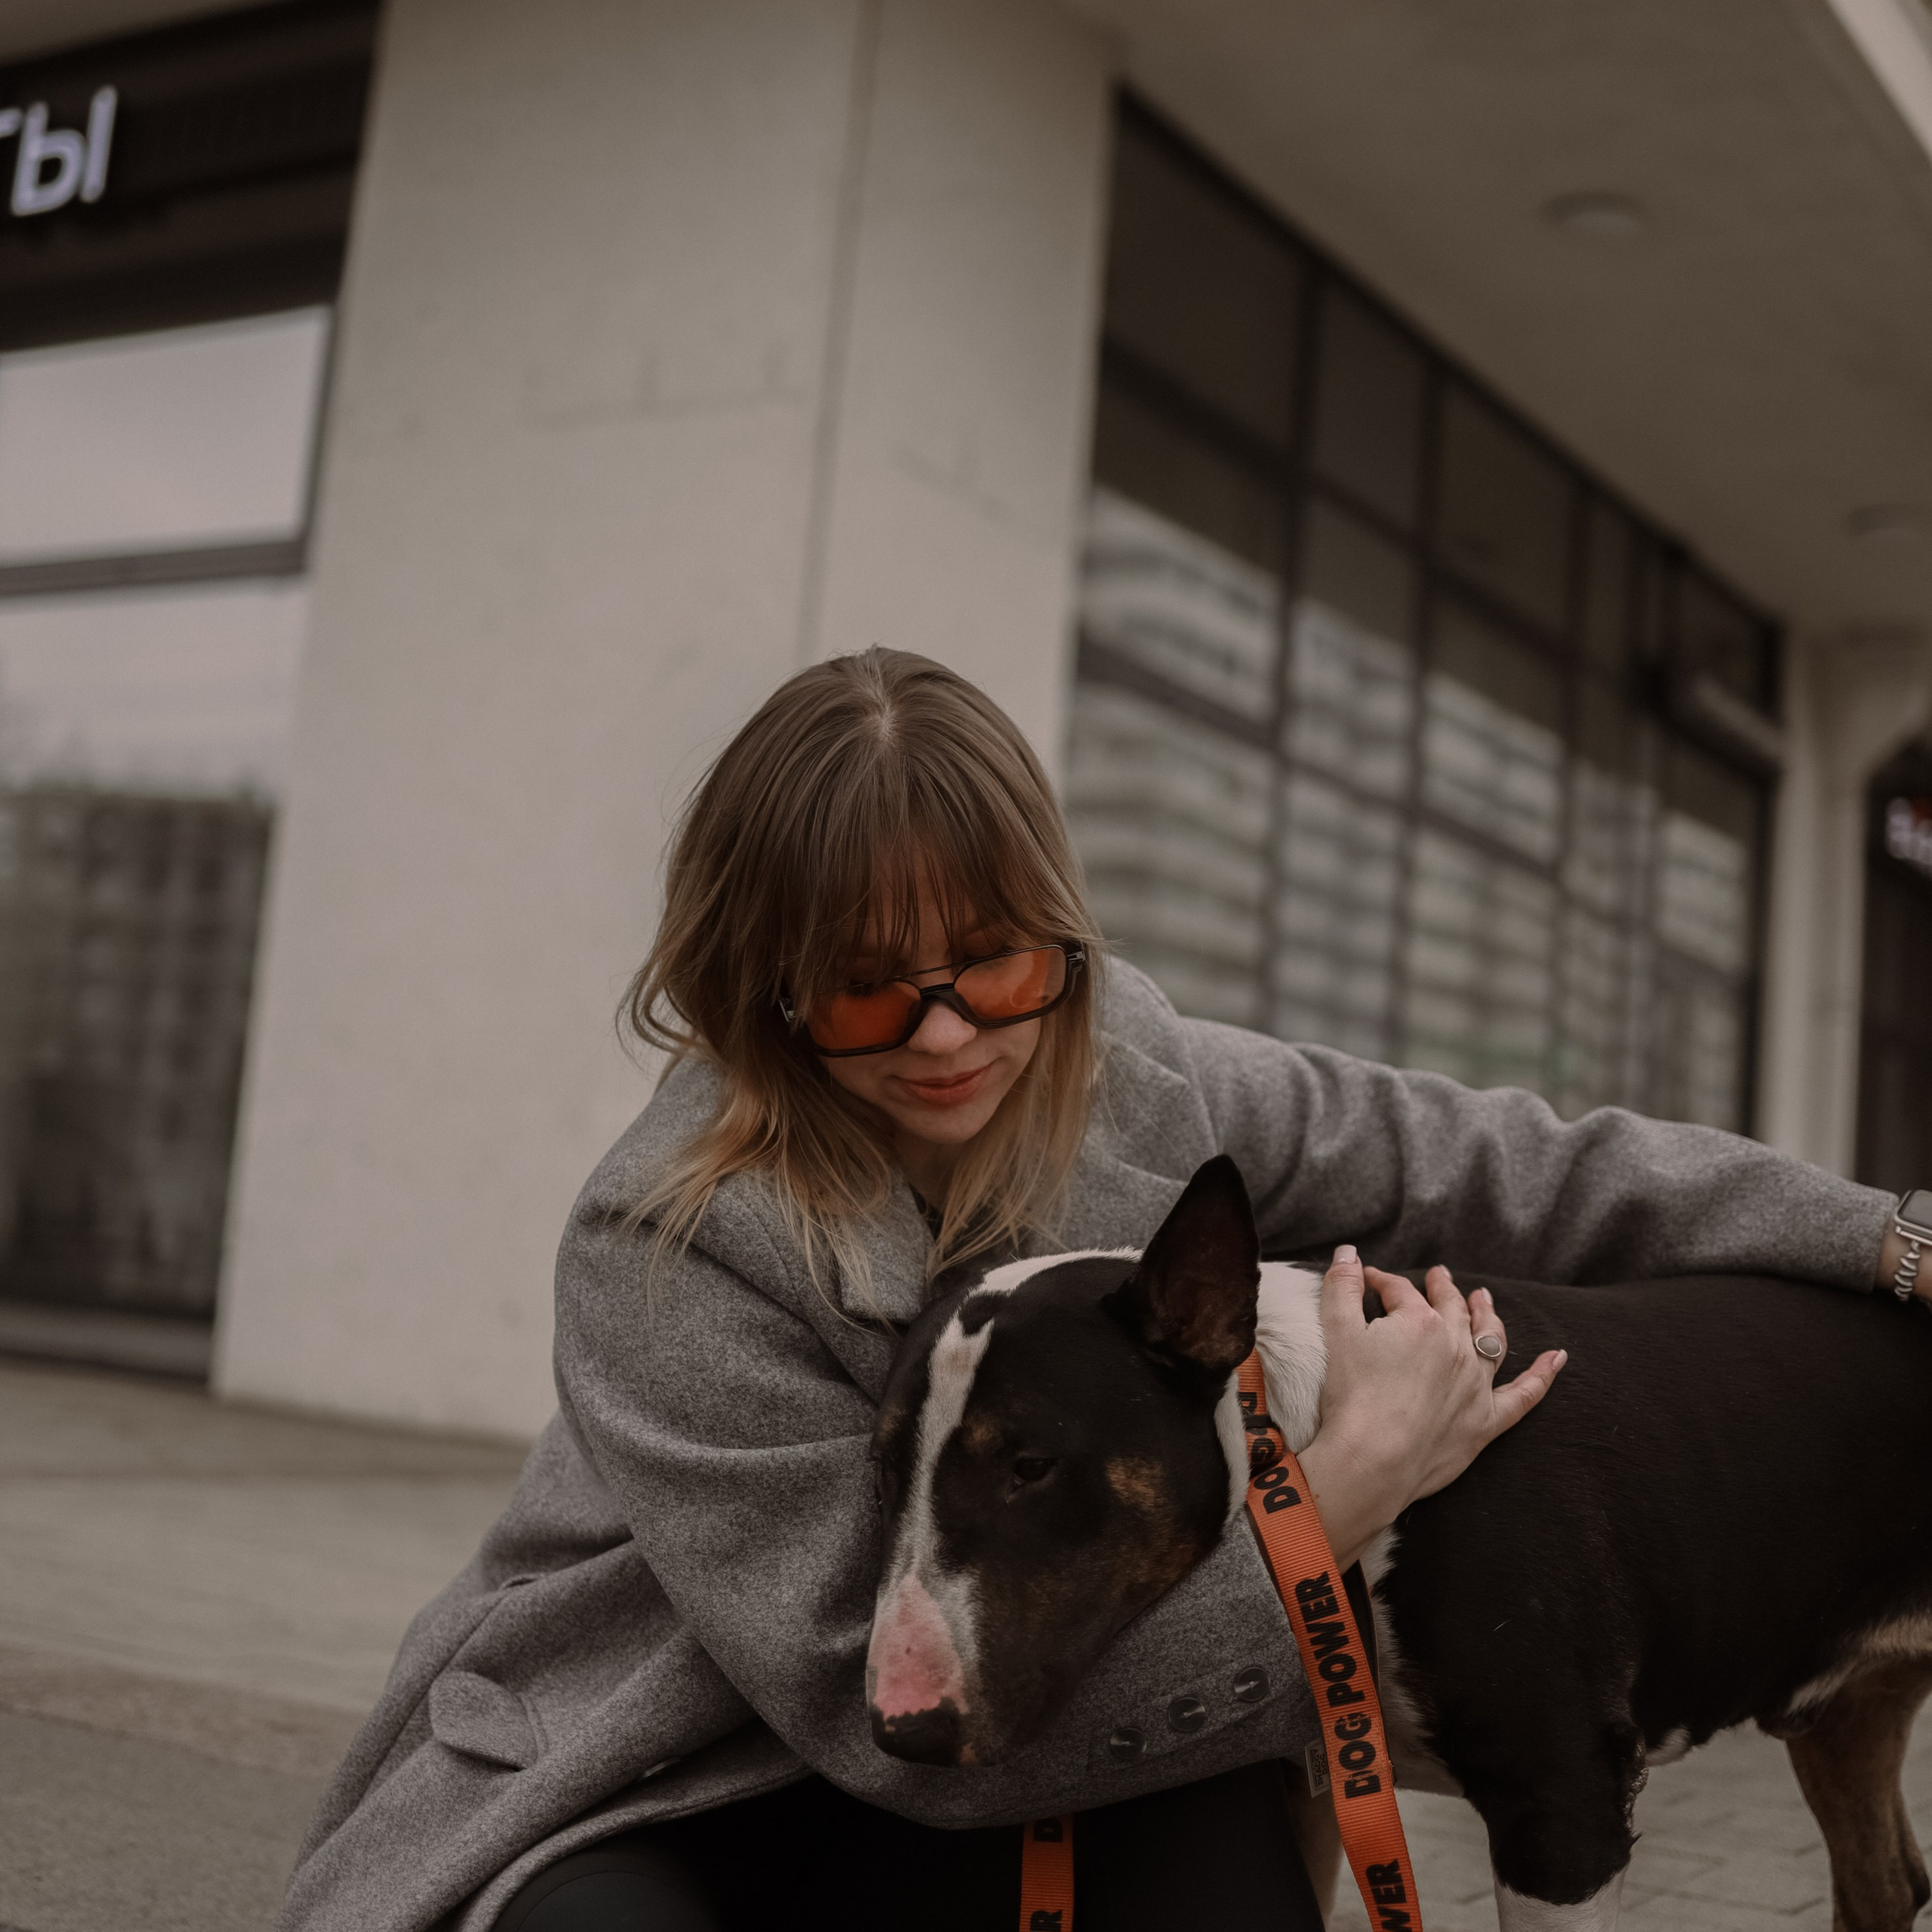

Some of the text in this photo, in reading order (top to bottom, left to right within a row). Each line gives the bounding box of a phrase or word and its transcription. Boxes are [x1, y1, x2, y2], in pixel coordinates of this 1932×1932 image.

[1295, 1571, 1381, 1799] DOG POWER
[1312, 1748, 1324, 1786] SHAGGY
[1319, 1753, 1327, 1775] DOG
